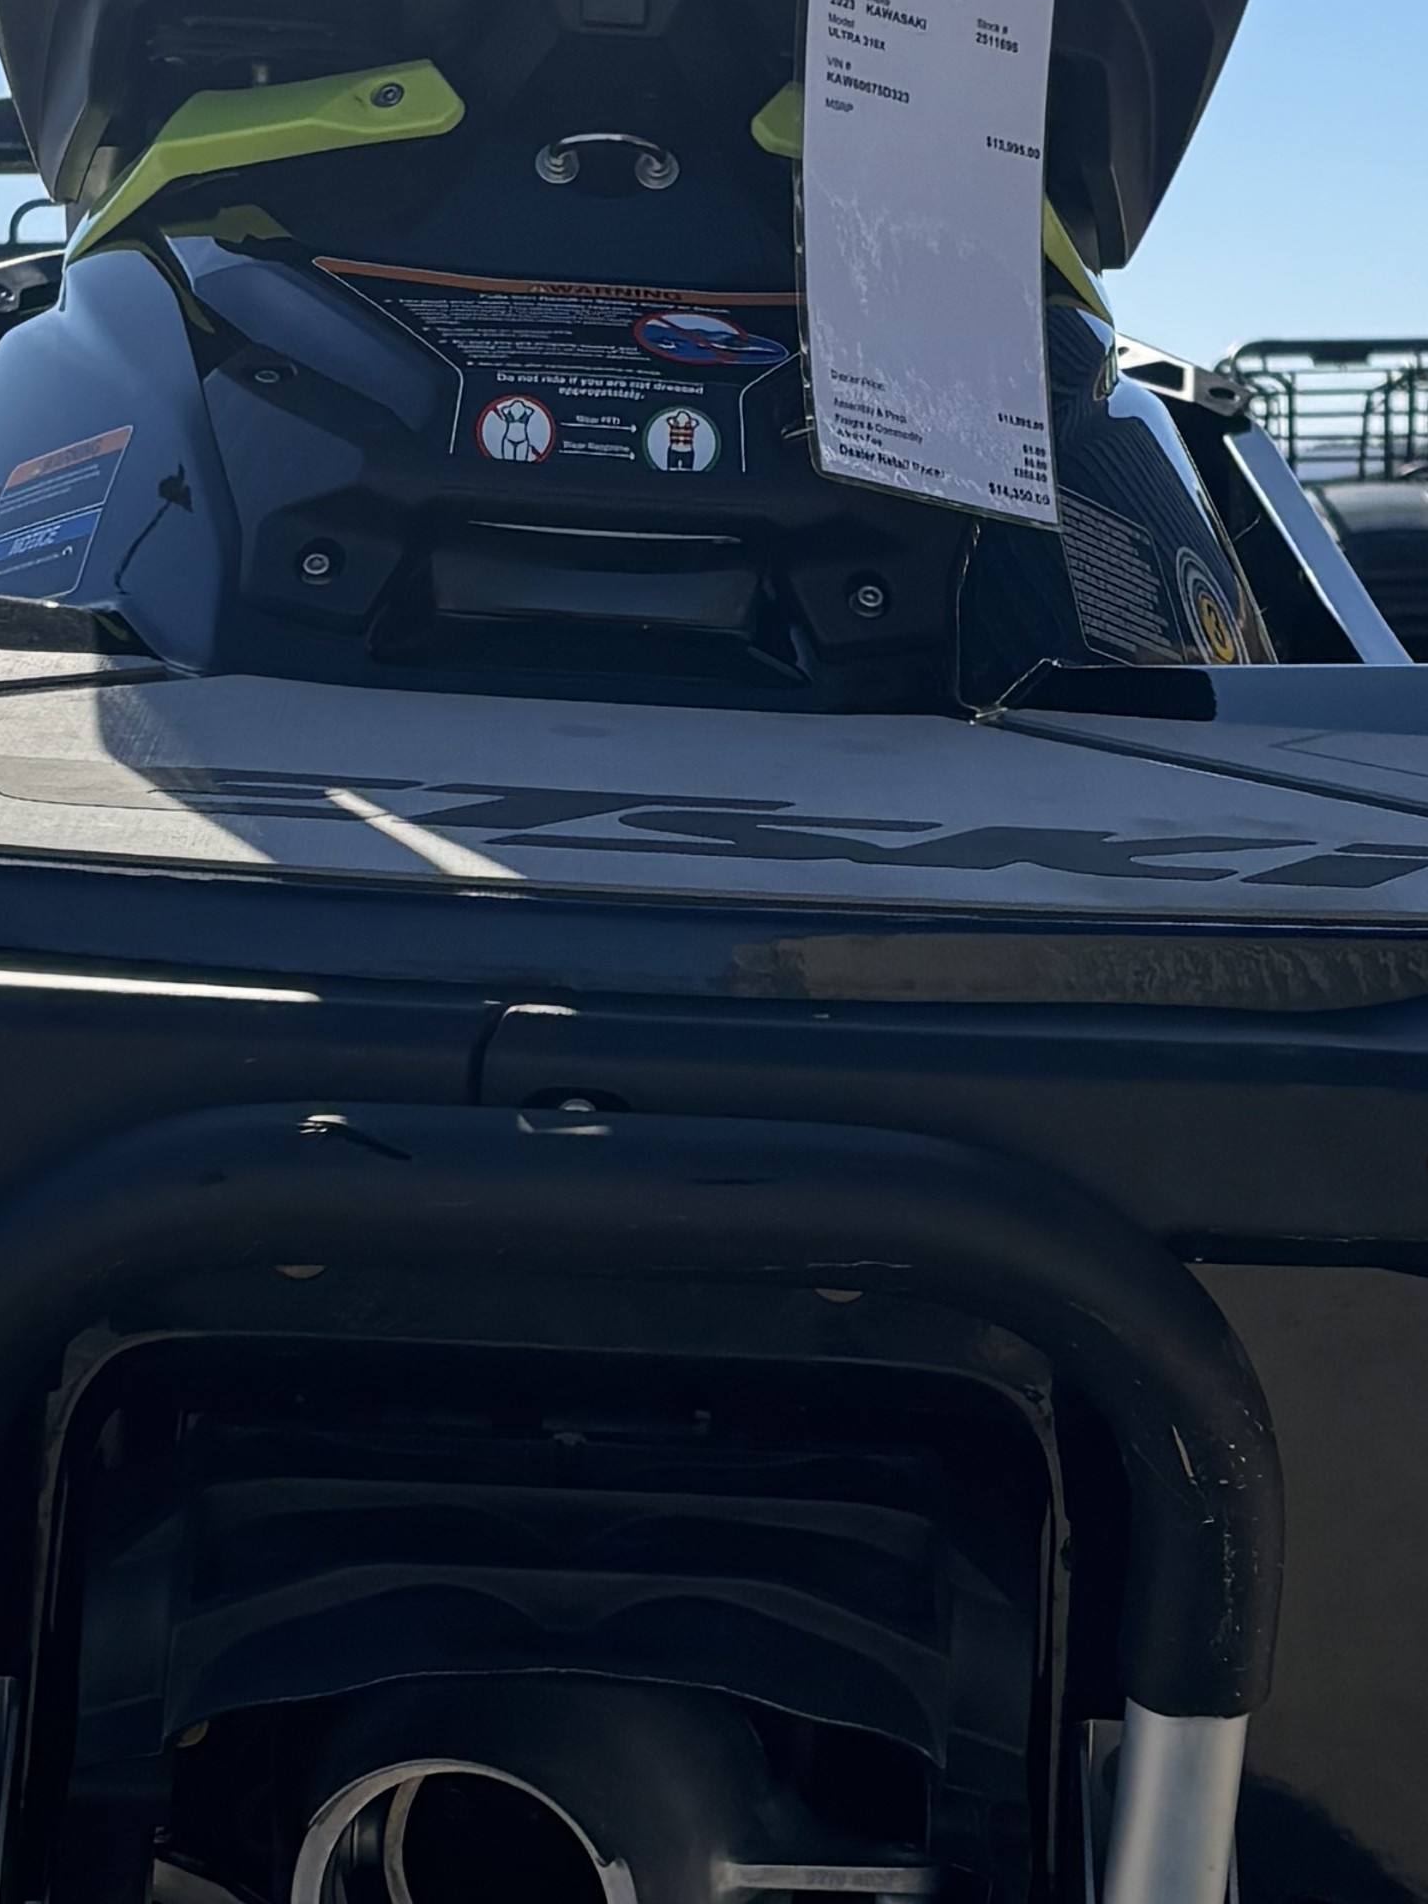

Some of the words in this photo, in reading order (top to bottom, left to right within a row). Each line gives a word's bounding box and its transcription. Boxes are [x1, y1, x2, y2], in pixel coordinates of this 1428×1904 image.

[828, 12, 854, 28] Model
[866, 4, 926, 30] KAWASAKI
[828, 26, 860, 44] ULTRA
[827, 55, 842, 68] VIN
[825, 97, 853, 114] MSRP
[546, 283, 680, 300] WARNING
